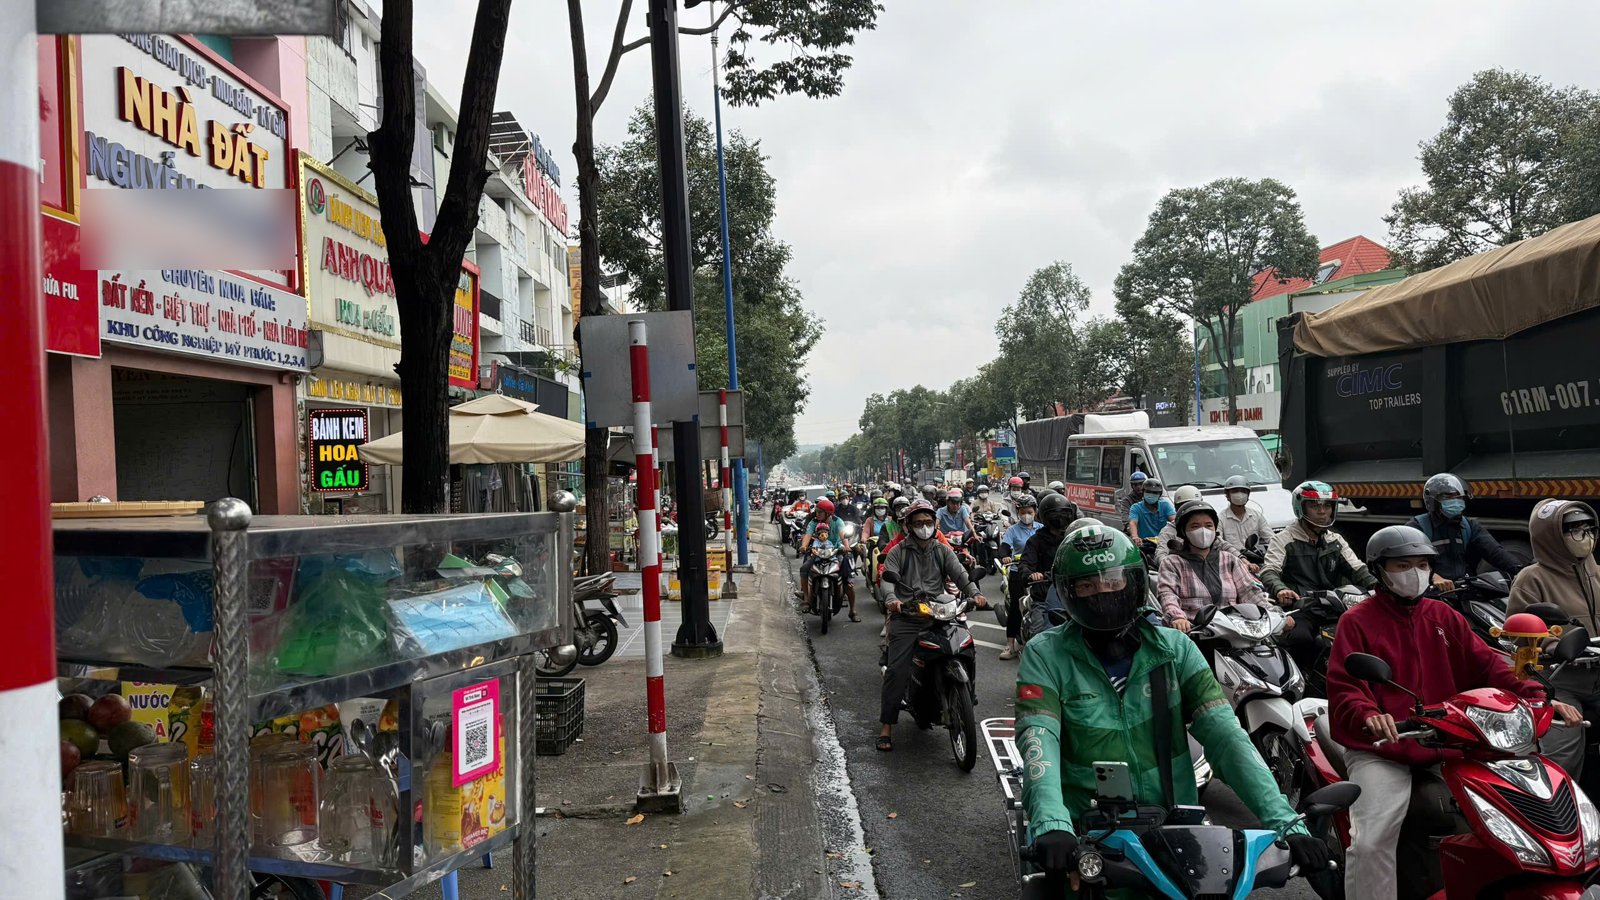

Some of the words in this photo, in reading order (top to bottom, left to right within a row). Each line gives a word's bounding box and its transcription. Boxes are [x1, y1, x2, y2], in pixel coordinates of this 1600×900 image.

[152, 35, 180, 71] GIAO
[180, 53, 206, 89] DỊCH
[212, 76, 233, 107] MUA
[117, 66, 201, 157] NHÀ
[207, 120, 269, 189] ĐẤT
[62, 281, 80, 301] FUL
[219, 279, 245, 304] MUA
[102, 273, 127, 310] ĐẤT
[218, 306, 237, 334] NHÀ
[107, 320, 139, 338] KHU
[143, 324, 179, 345] CÔNG
[1336, 363, 1403, 398] CIMC
[1244, 407, 1263, 421] DANH
[1369, 398, 1383, 411] TOP
[1384, 393, 1422, 409] TRAILERS
[312, 413, 341, 440] BÁNH
[342, 416, 365, 440] KEM
[319, 444, 359, 462] HOA
[320, 464, 360, 488] GẤU
[1082, 550, 1116, 566] Grab
[129, 690, 170, 709] NƯỚC
